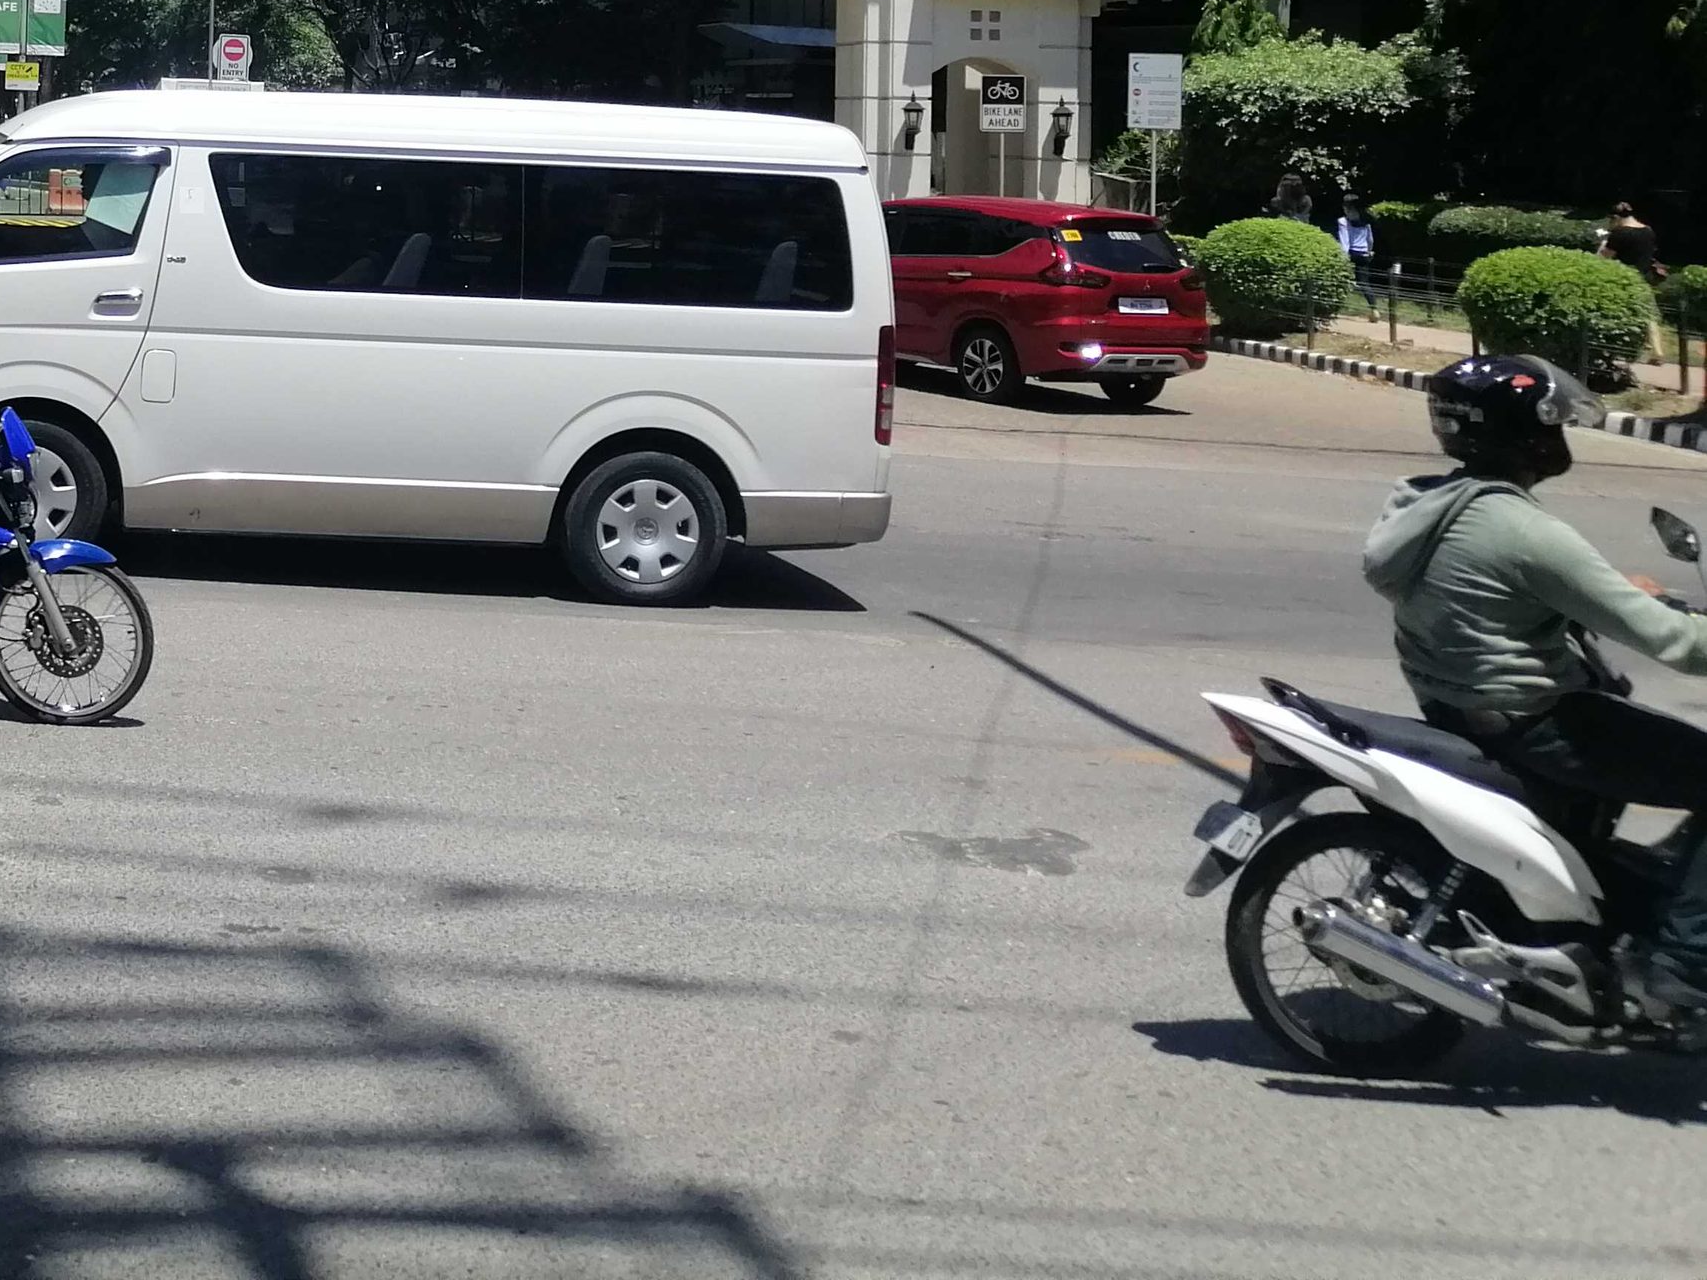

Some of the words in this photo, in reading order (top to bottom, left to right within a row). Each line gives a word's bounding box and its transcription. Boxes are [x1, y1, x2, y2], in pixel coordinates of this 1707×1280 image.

[984, 107, 1002, 116] BIKE
[1004, 107, 1023, 116] LANE
[988, 118, 1020, 128] AHEAD
